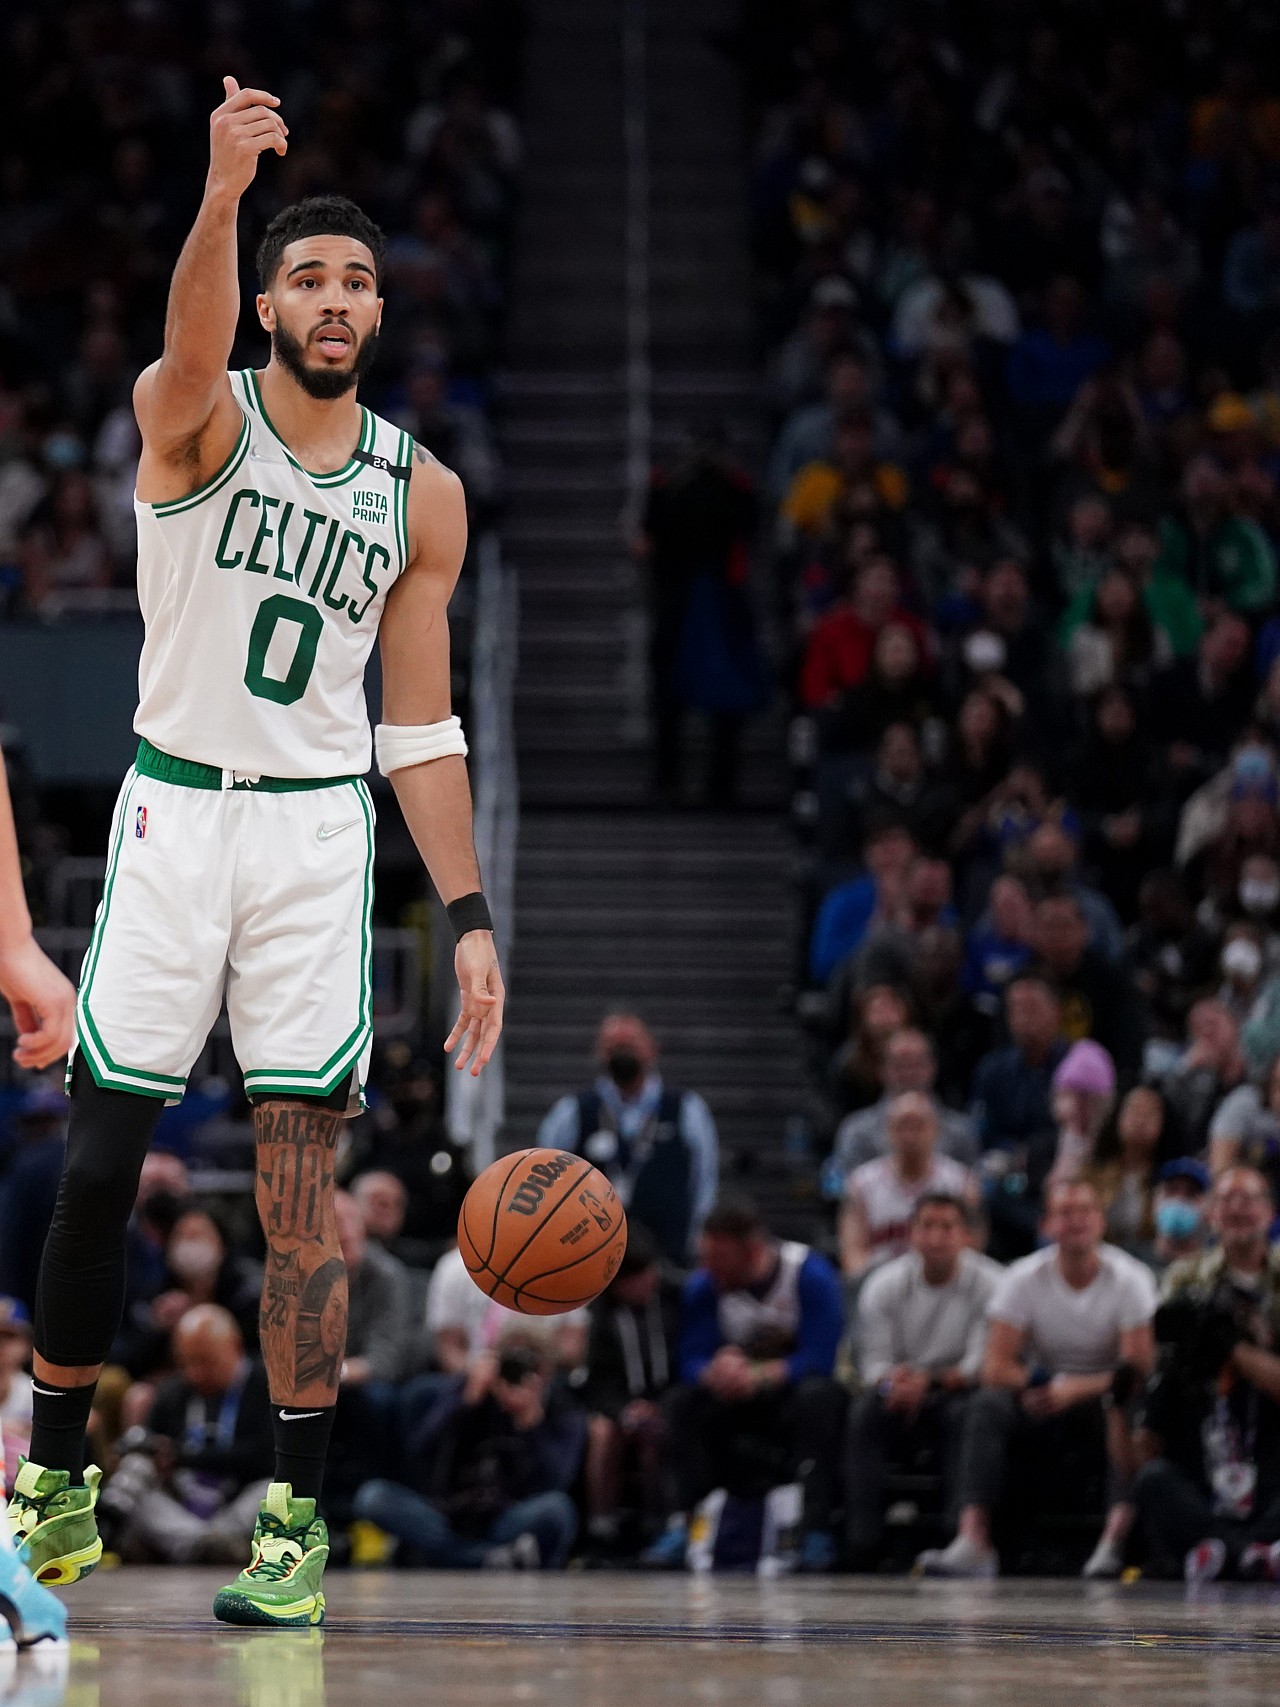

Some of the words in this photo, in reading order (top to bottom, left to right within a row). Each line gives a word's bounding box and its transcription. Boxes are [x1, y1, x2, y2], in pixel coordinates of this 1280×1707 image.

[373, 457, 388, 470] 24
[352, 506, 388, 525] PRINT
[353, 490, 388, 513] VISTA
[215, 488, 391, 624] CELTICS
[244, 593, 325, 706] 0
[255, 1108, 340, 1149] GRATEFU
